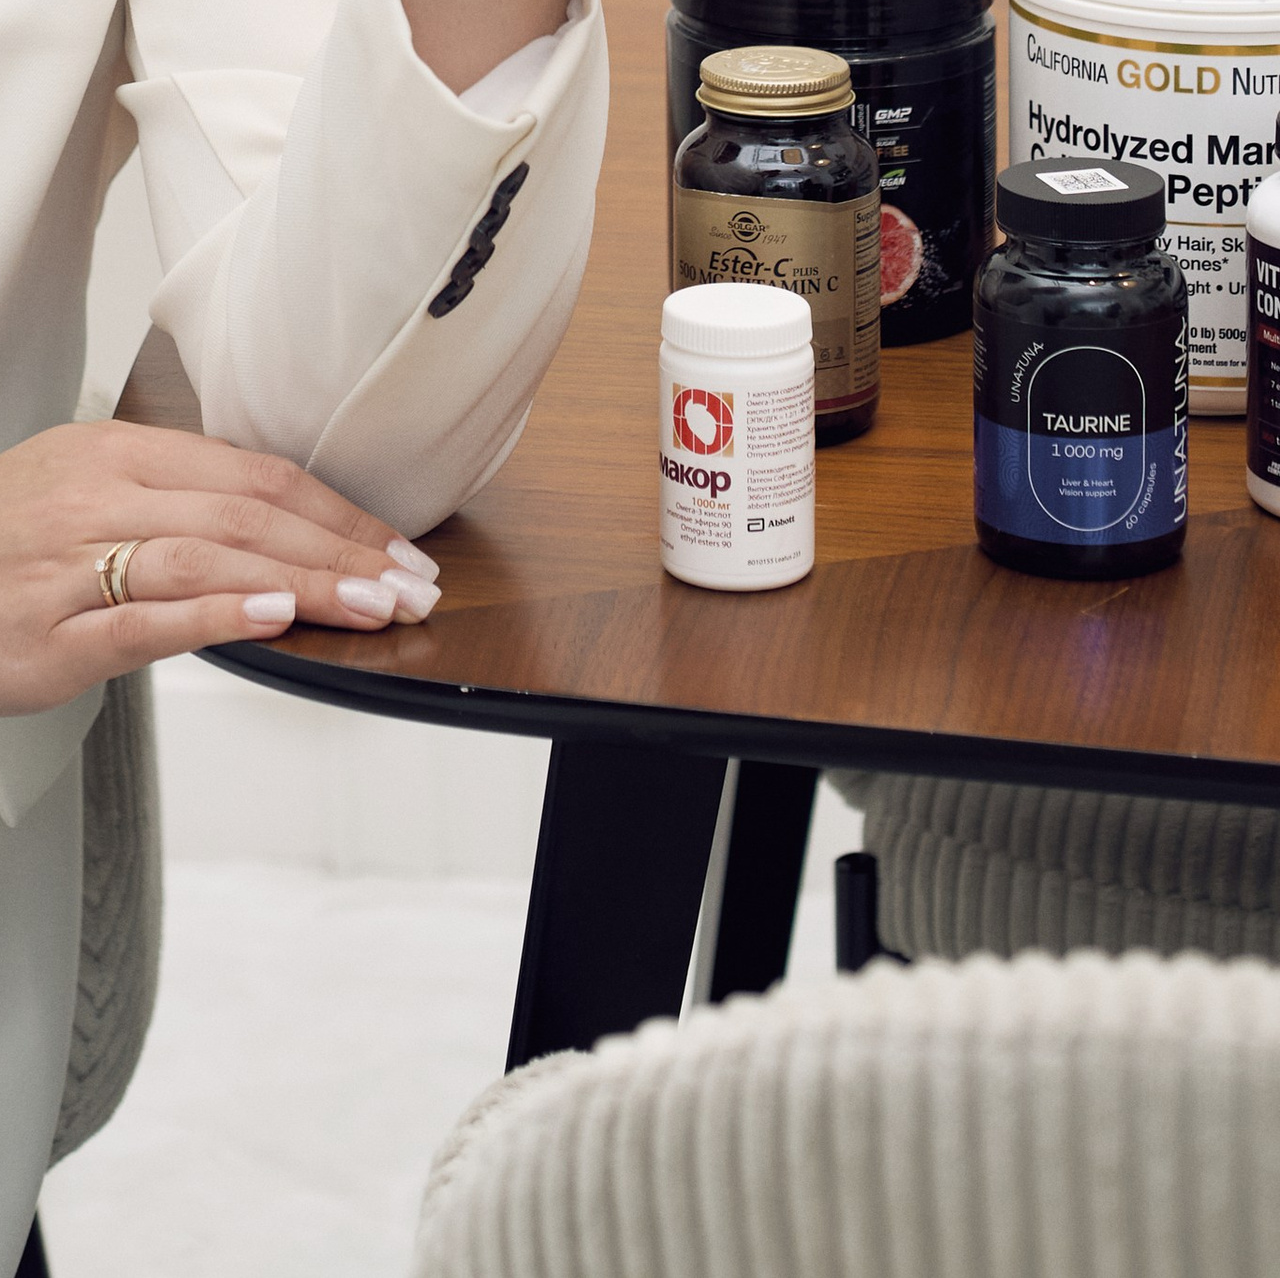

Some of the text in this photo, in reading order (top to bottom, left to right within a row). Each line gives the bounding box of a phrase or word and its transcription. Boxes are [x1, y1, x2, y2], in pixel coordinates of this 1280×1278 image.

[1027, 33, 1109, 85] CALIFORNIA
[1116, 58, 1222, 95] GOLD
[874, 107, 914, 121] GMP
[1028, 99, 1194, 165] Hydrolyzed
[727, 220, 766, 233] SOLGAR
[762, 234, 788, 244] 1947
[1177, 235, 1216, 255] Hair,
[1221, 238, 1245, 253] Sk
[708, 249, 820, 278] Ester-C PLUS
[679, 259, 697, 282] 500
[827, 276, 840, 292] C
[1256, 257, 1280, 290] VIT
[1187, 281, 1211, 297] ght
[1200, 327, 1216, 342] lb)
[1188, 342, 1217, 354] ment
[1192, 358, 1202, 366] Do
[1203, 358, 1215, 367] not
[1043, 412, 1131, 433] TAURINE
[1051, 444, 1124, 461] 1 000 mg
[659, 449, 732, 499] макор
[1061, 478, 1114, 487] Liver & Heart
[1058, 487, 1117, 497] Vision support
[1125, 462, 1157, 530] 60 capsules
[692, 496, 731, 511] 1000 мг
[704, 511, 731, 519] кислот
[768, 515, 795, 528] Abbott
[680, 522, 732, 539] Omega-3-acid
[695, 518, 720, 528] эфиры
[721, 521, 732, 529] 90
[680, 534, 697, 545] ethyl
[697, 539, 720, 548] esters
[721, 540, 732, 549] 90
